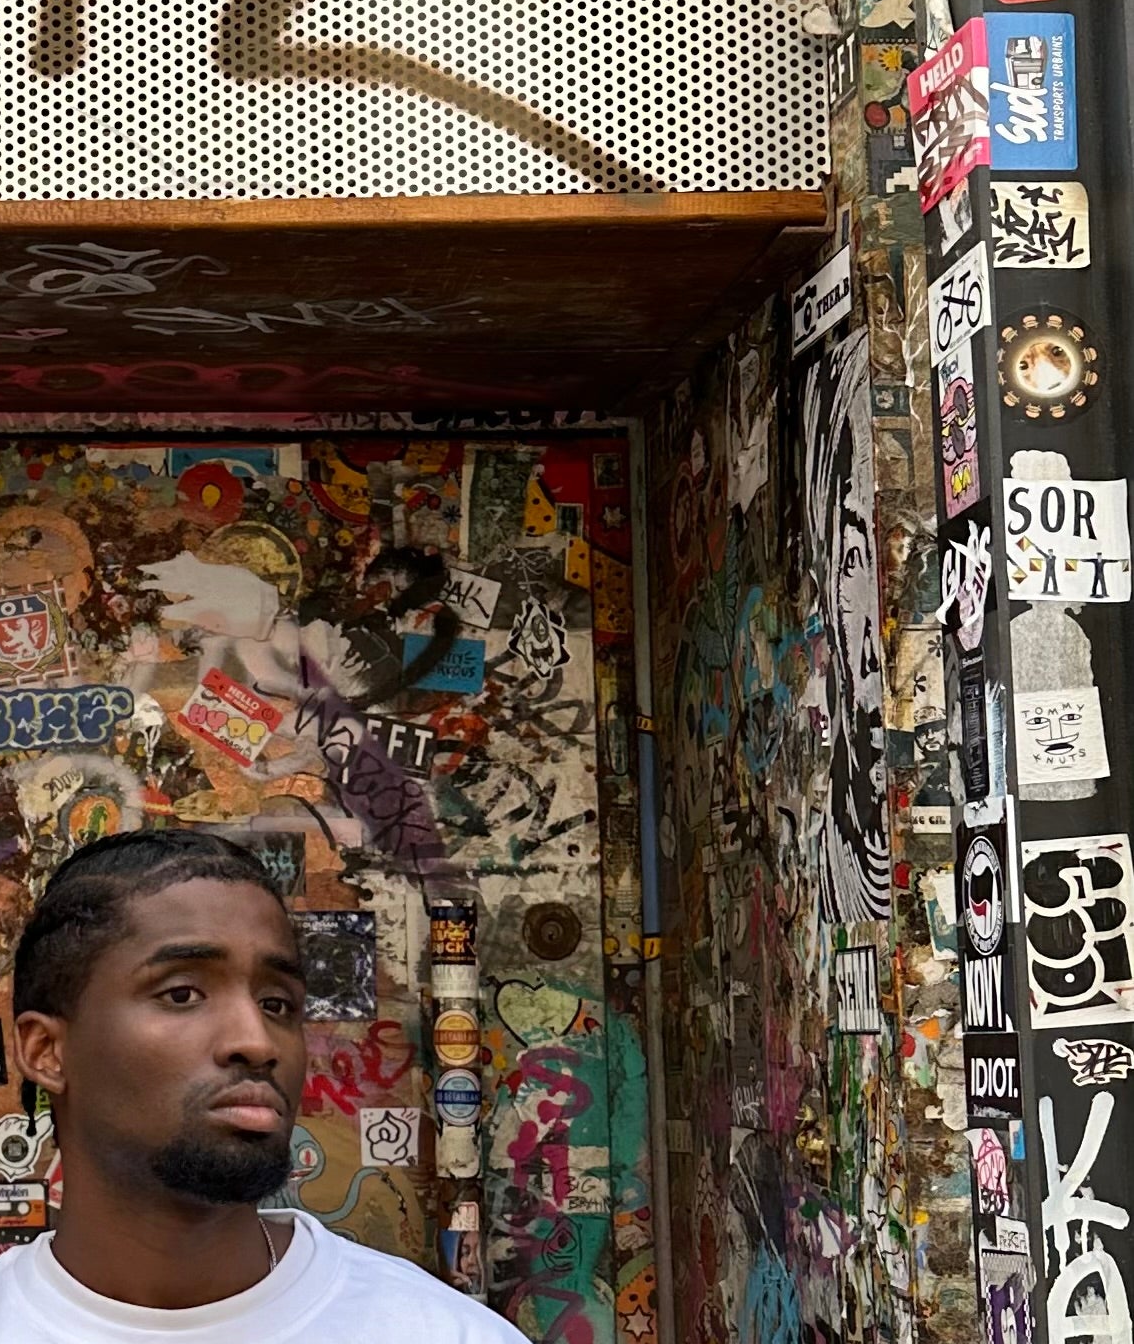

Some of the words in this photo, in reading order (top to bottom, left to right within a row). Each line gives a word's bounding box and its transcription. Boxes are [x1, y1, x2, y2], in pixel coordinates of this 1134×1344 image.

[919, 41, 964, 97] HELLO
[1052, 34, 1064, 78] URBAINS
[1053, 80, 1065, 142] TRANSPORTS
[0, 601, 34, 617] OL
[228, 685, 261, 711] HELLO
[1020, 702, 1086, 718] TOMMY
[1032, 747, 1086, 765] KNUTS
[970, 1057, 1019, 1100] IDIOT.
